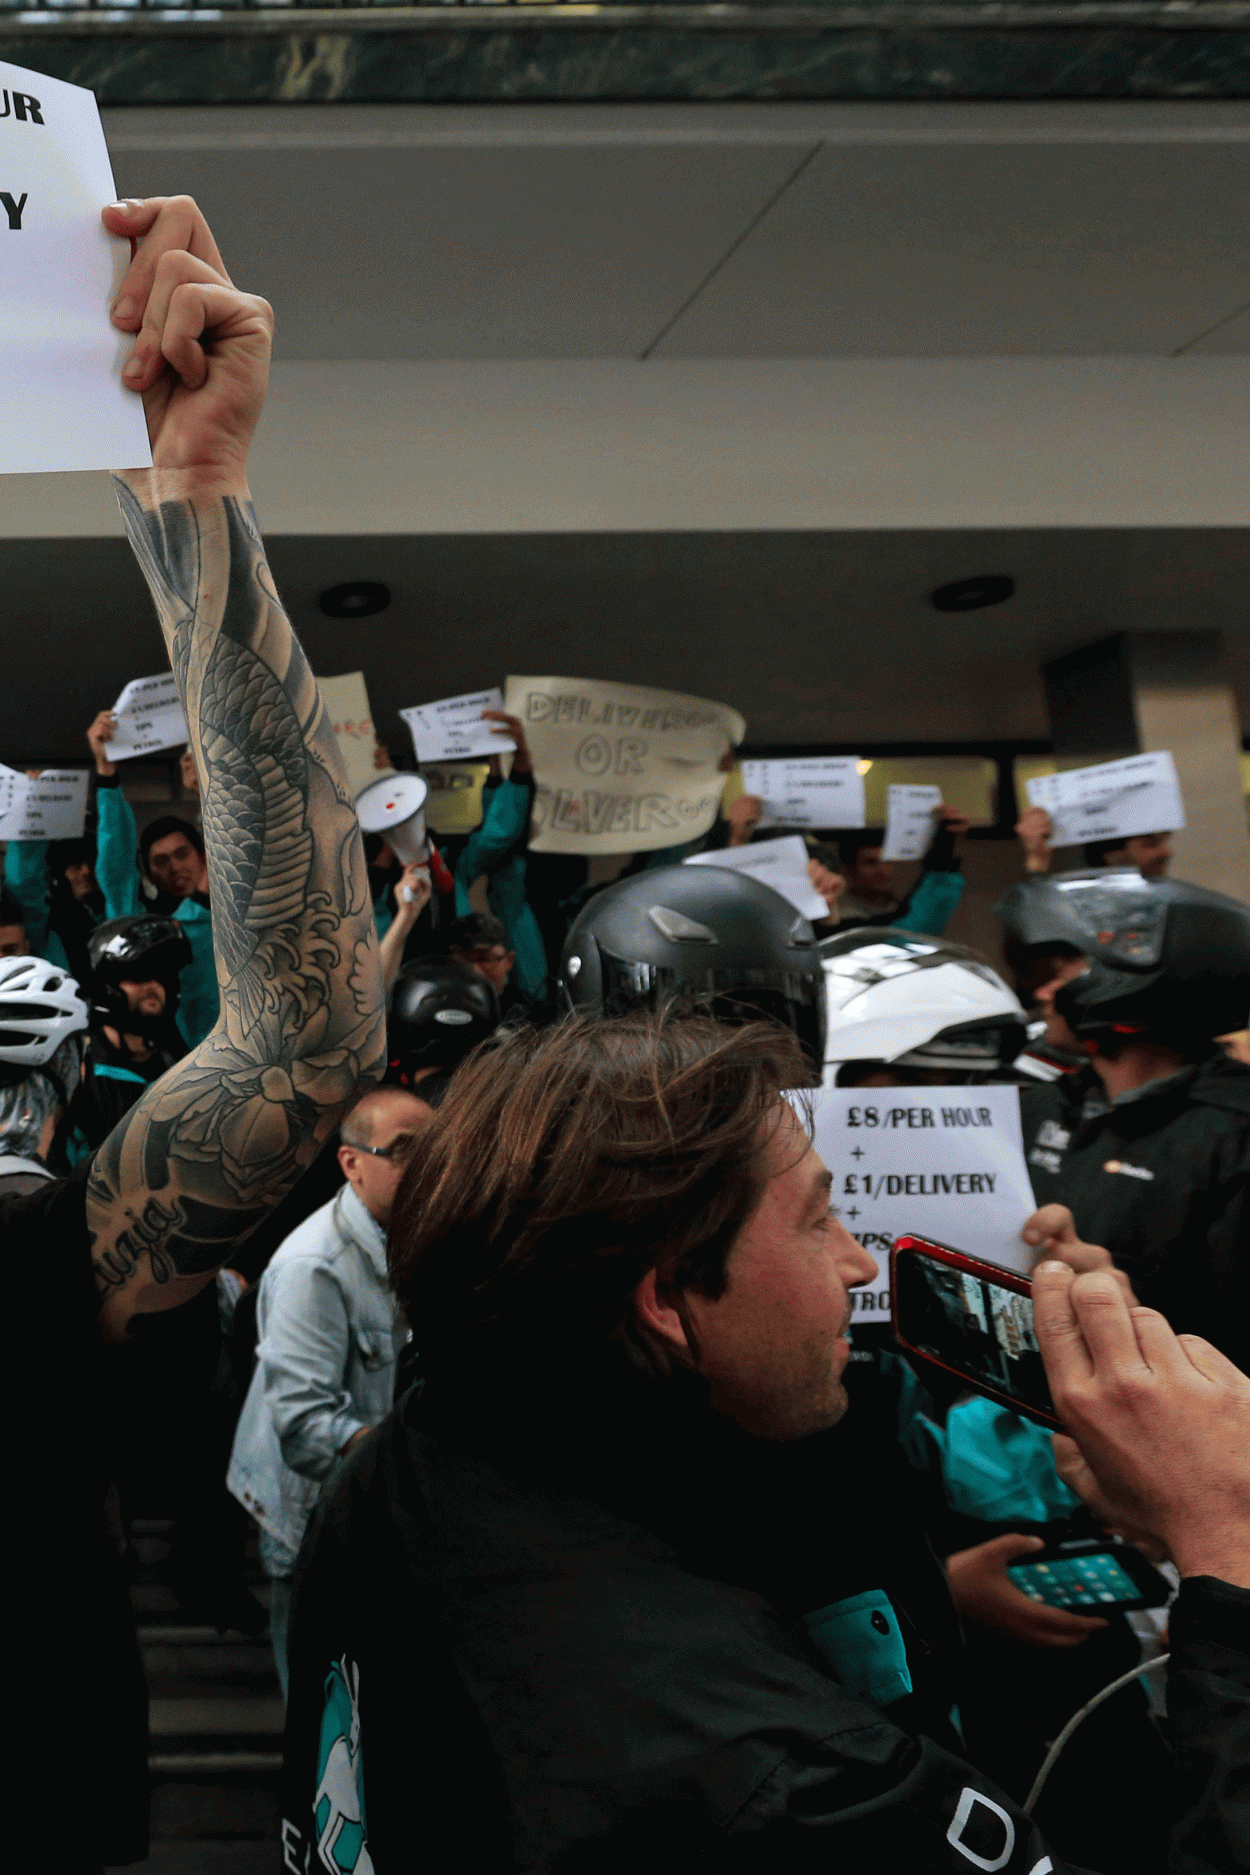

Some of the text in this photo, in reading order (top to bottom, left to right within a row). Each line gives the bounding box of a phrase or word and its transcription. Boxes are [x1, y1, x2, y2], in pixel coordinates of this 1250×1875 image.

[574, 731, 649, 777] OR
[847, 1106, 993, 1129] £8/PER HOUR
[843, 1173, 997, 1200] £1/DELIVERY
